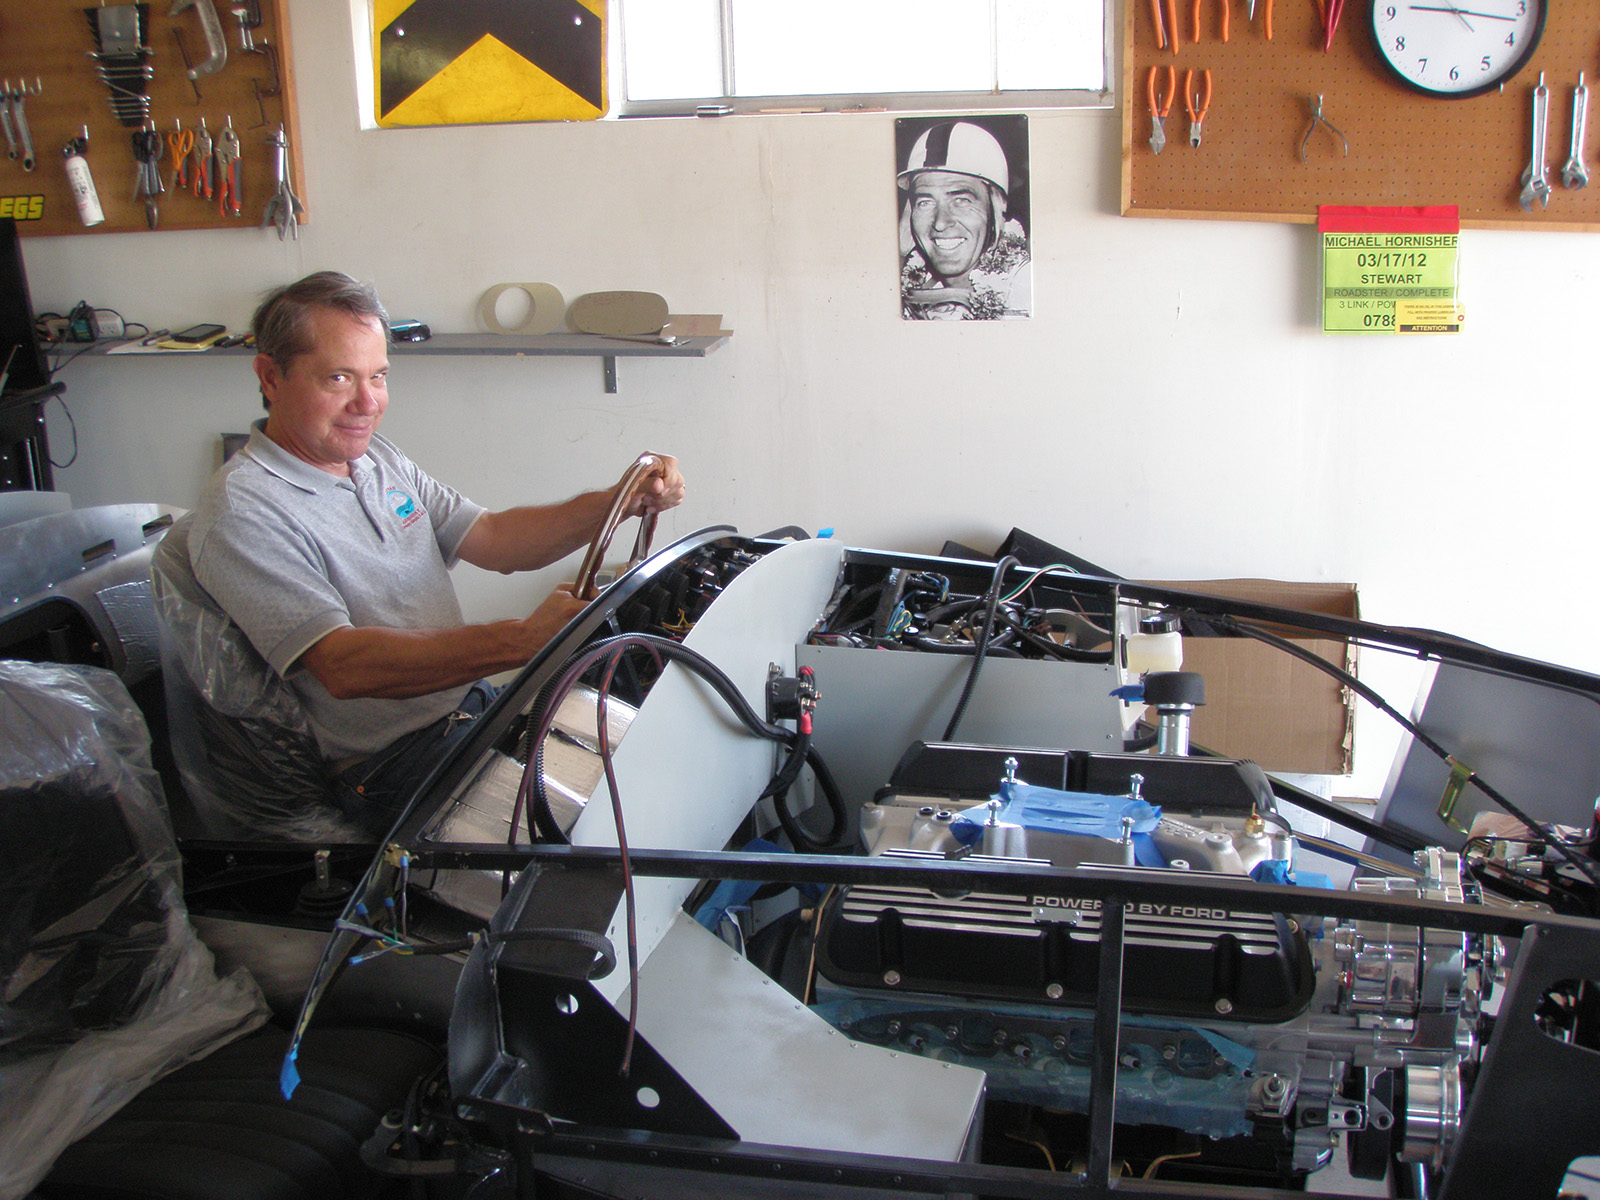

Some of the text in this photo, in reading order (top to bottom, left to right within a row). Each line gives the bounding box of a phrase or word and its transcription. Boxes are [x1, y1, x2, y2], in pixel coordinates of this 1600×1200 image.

[1386, 6, 1397, 21] 9
[1516, 1, 1526, 17] 3
[1395, 36, 1406, 51] 8
[1504, 32, 1515, 47] 4
[1418, 58, 1428, 73] 7
[1480, 56, 1491, 71] 5
[1449, 65, 1459, 81] 6
[1326, 236, 1381, 247] MICHAEL
[1357, 253, 1427, 267] 03/17/12
[1361, 274, 1422, 284] STEWART
[1333, 289, 1387, 297] ROADSTER
[1395, 288, 1449, 297] COMPLETE
[1339, 301, 1346, 309] 3
[1347, 301, 1369, 309] LINK
[1138, 903, 1167, 916] BY
[1170, 905, 1227, 920] FORD
